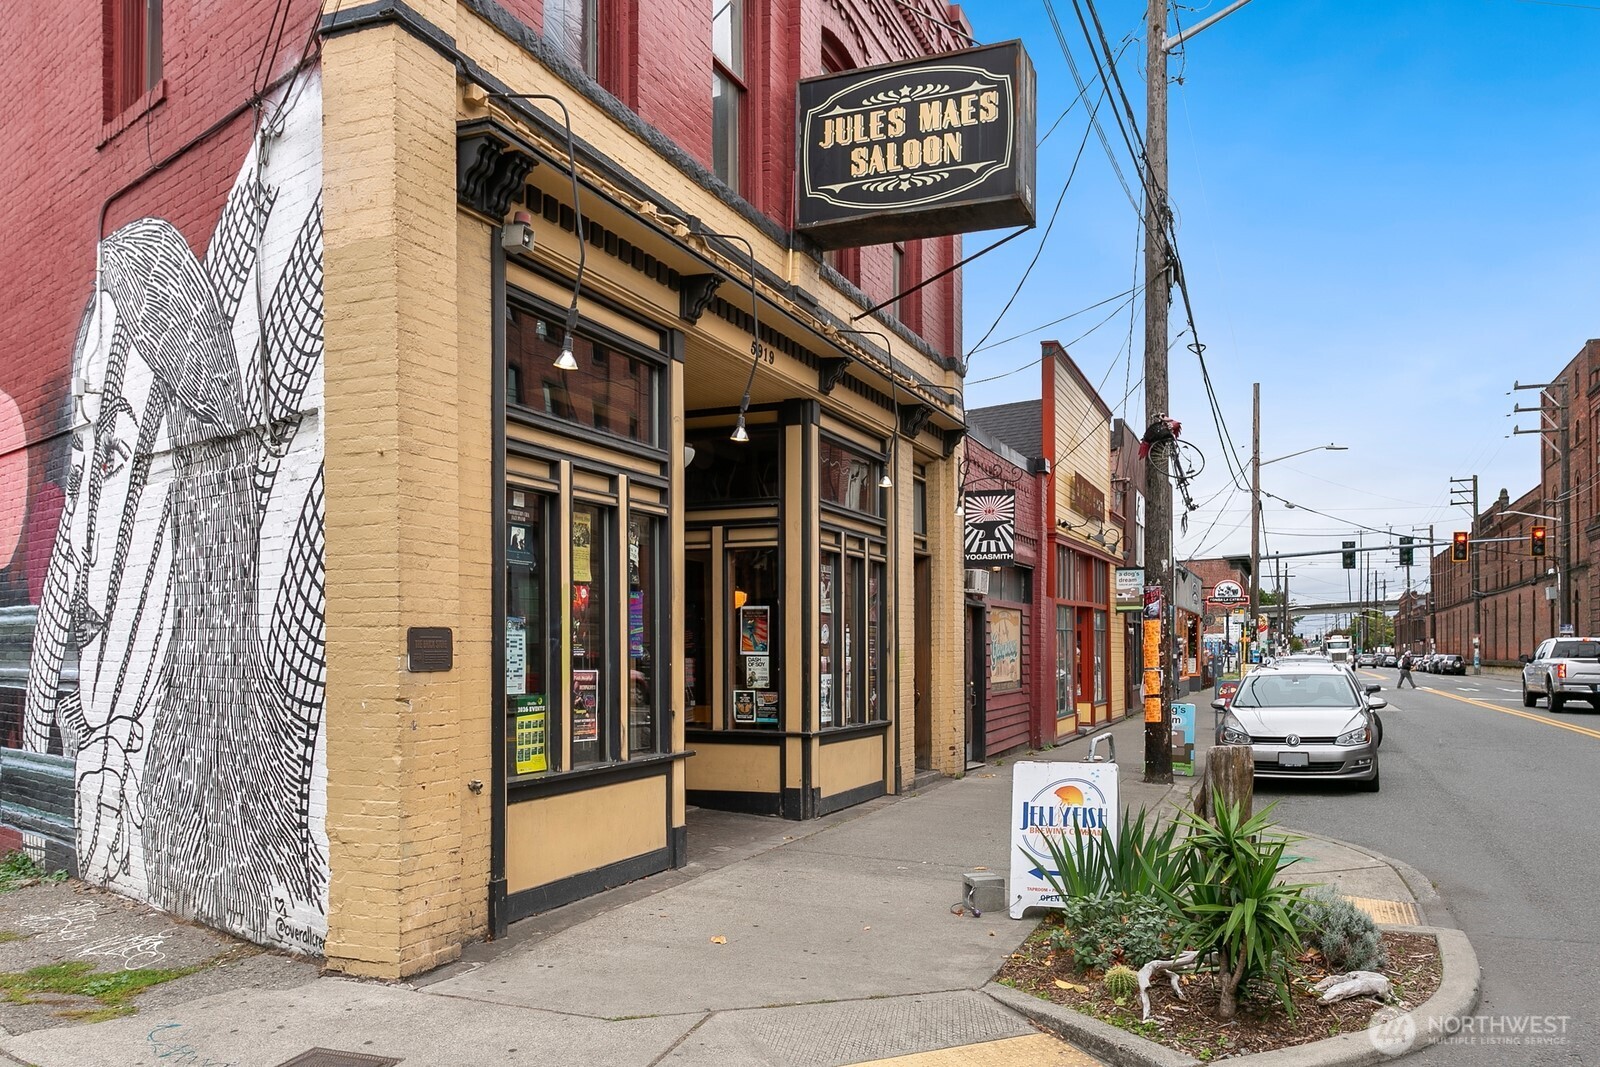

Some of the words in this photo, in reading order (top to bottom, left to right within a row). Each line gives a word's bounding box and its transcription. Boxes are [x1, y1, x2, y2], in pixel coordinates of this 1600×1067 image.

[819, 106, 906, 149] JULES
[919, 90, 999, 133] MAES
[850, 131, 963, 177] SALOON
[751, 341, 775, 365] 5919
[965, 553, 1014, 561] YOGASMITH
[1019, 802, 1108, 831] JELLYFISH
[1029, 827, 1067, 835] BREWING
[1040, 894, 1060, 902] OPEN
